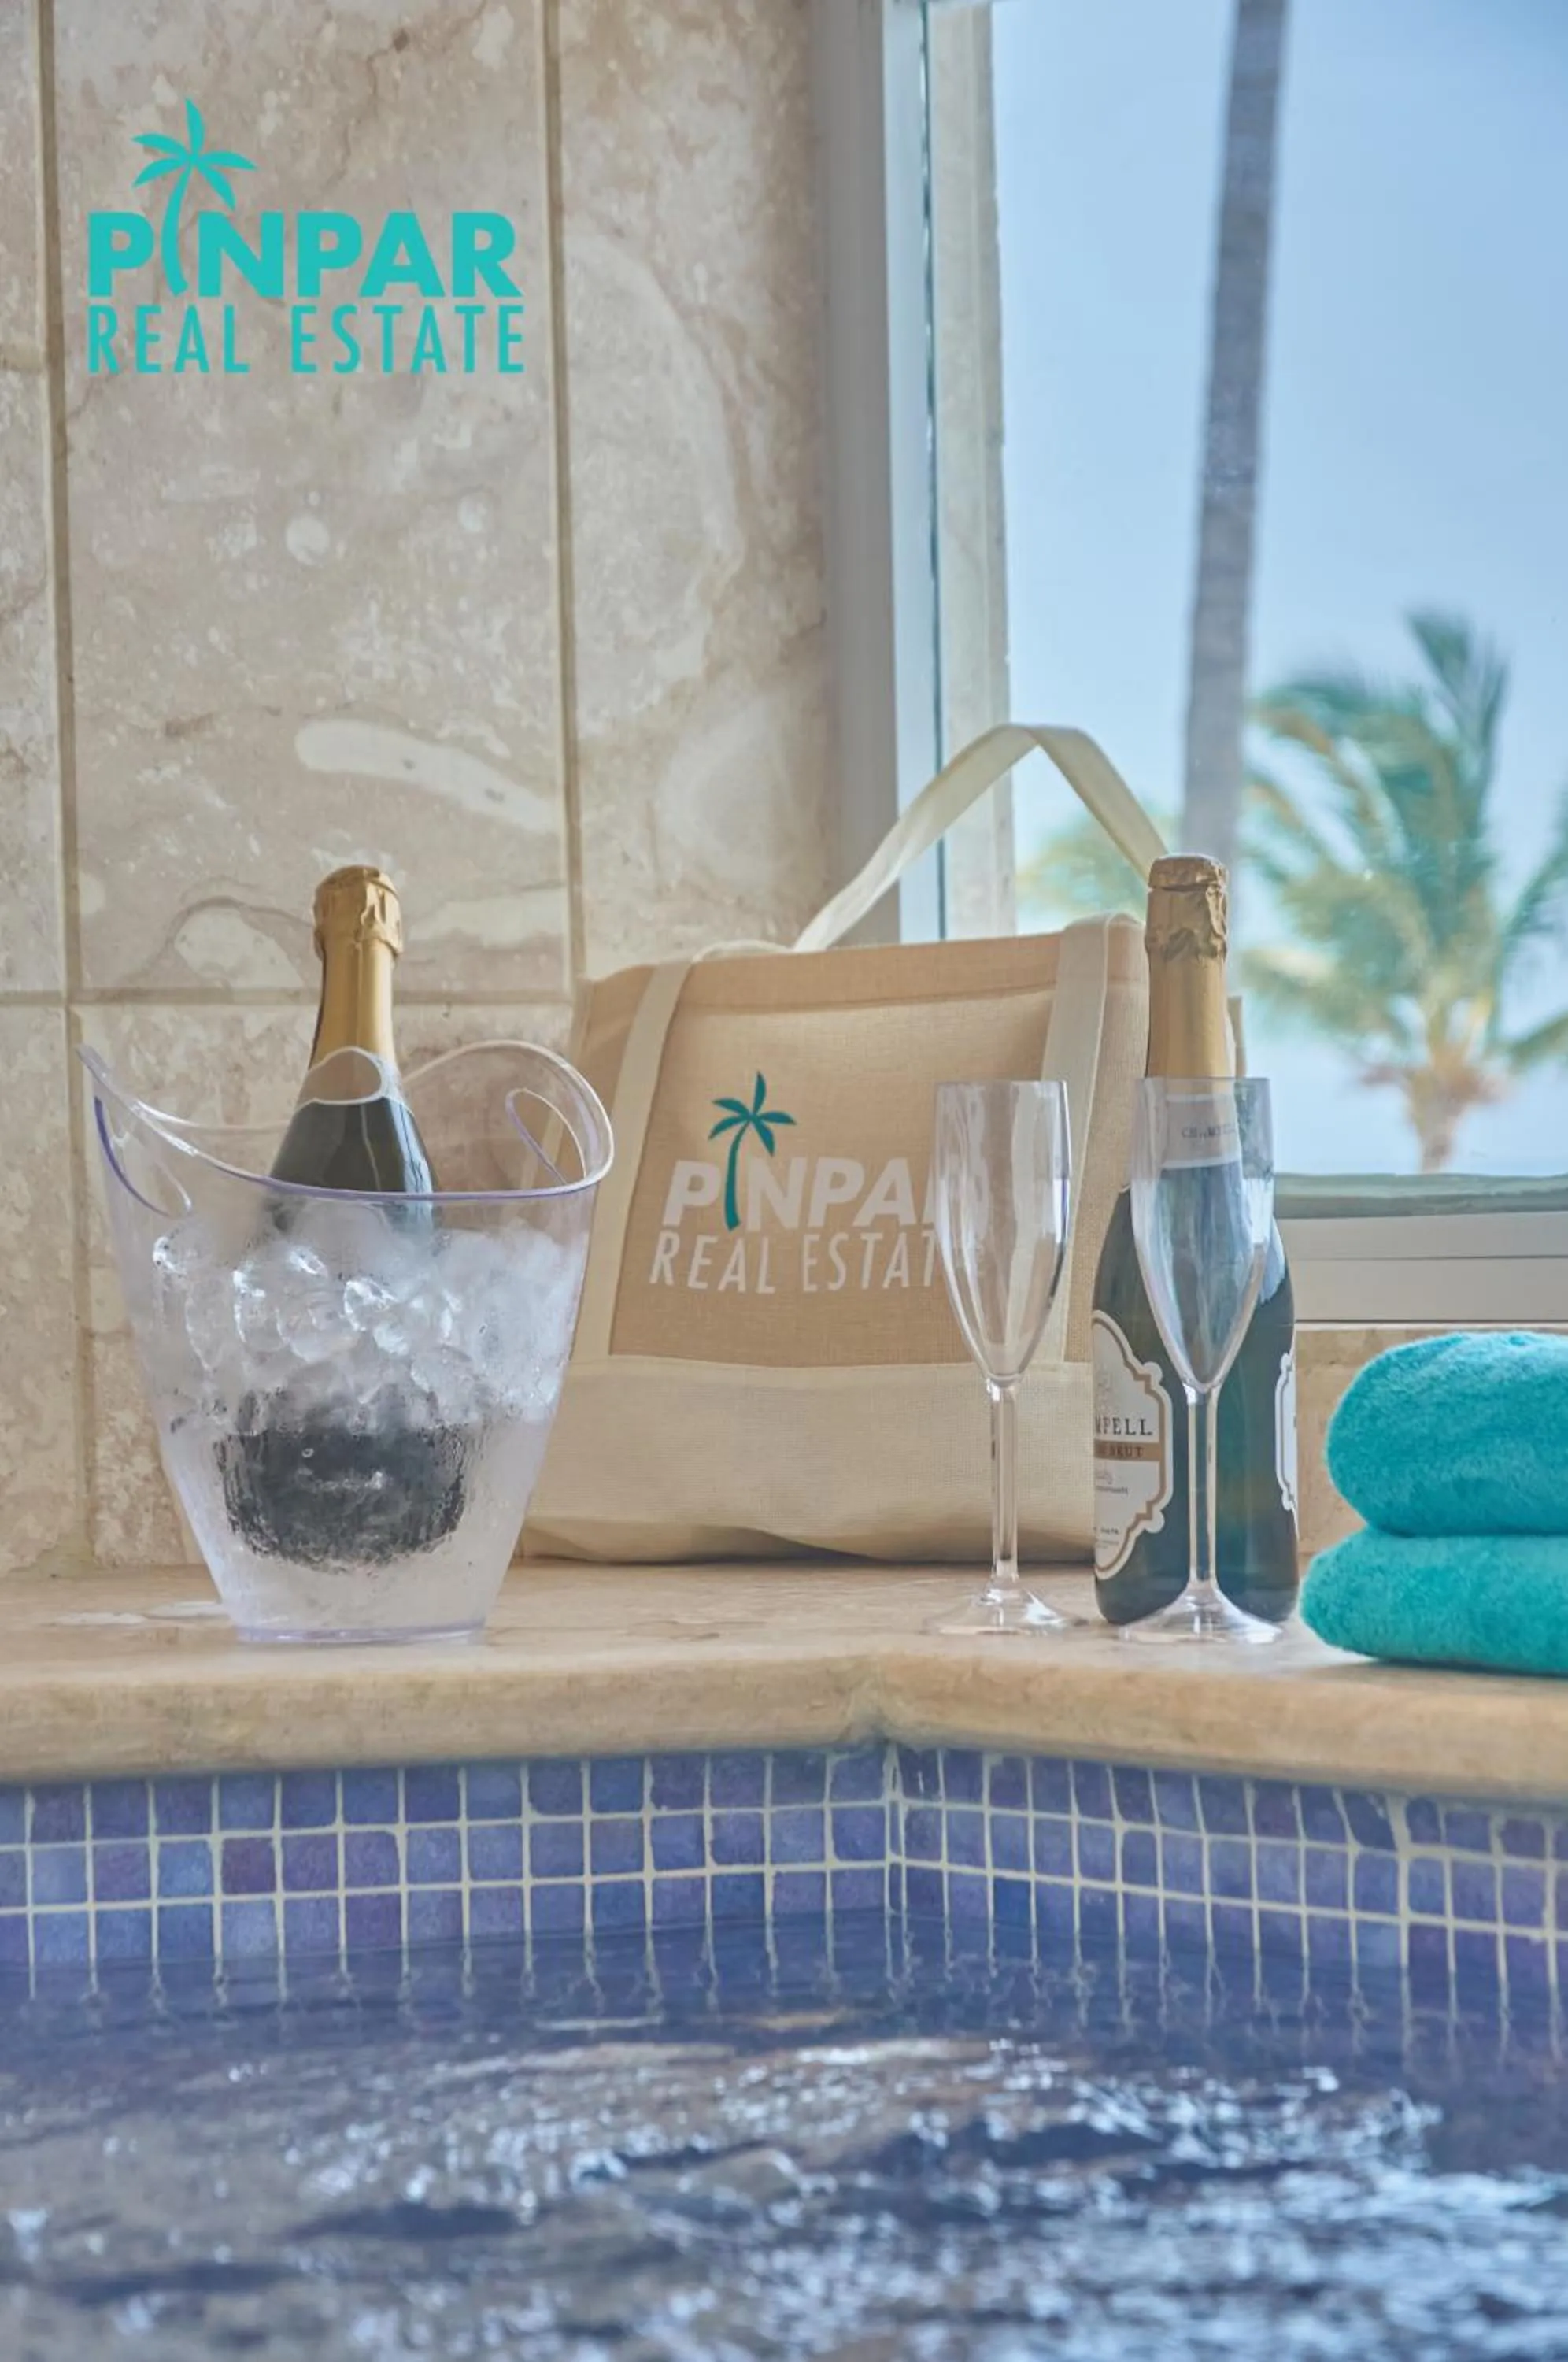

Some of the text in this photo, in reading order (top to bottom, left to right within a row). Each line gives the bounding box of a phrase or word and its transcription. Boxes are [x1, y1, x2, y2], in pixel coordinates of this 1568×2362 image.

[663, 1121, 938, 1232] PINPA
[649, 1231, 938, 1294] REAL ESTAT
